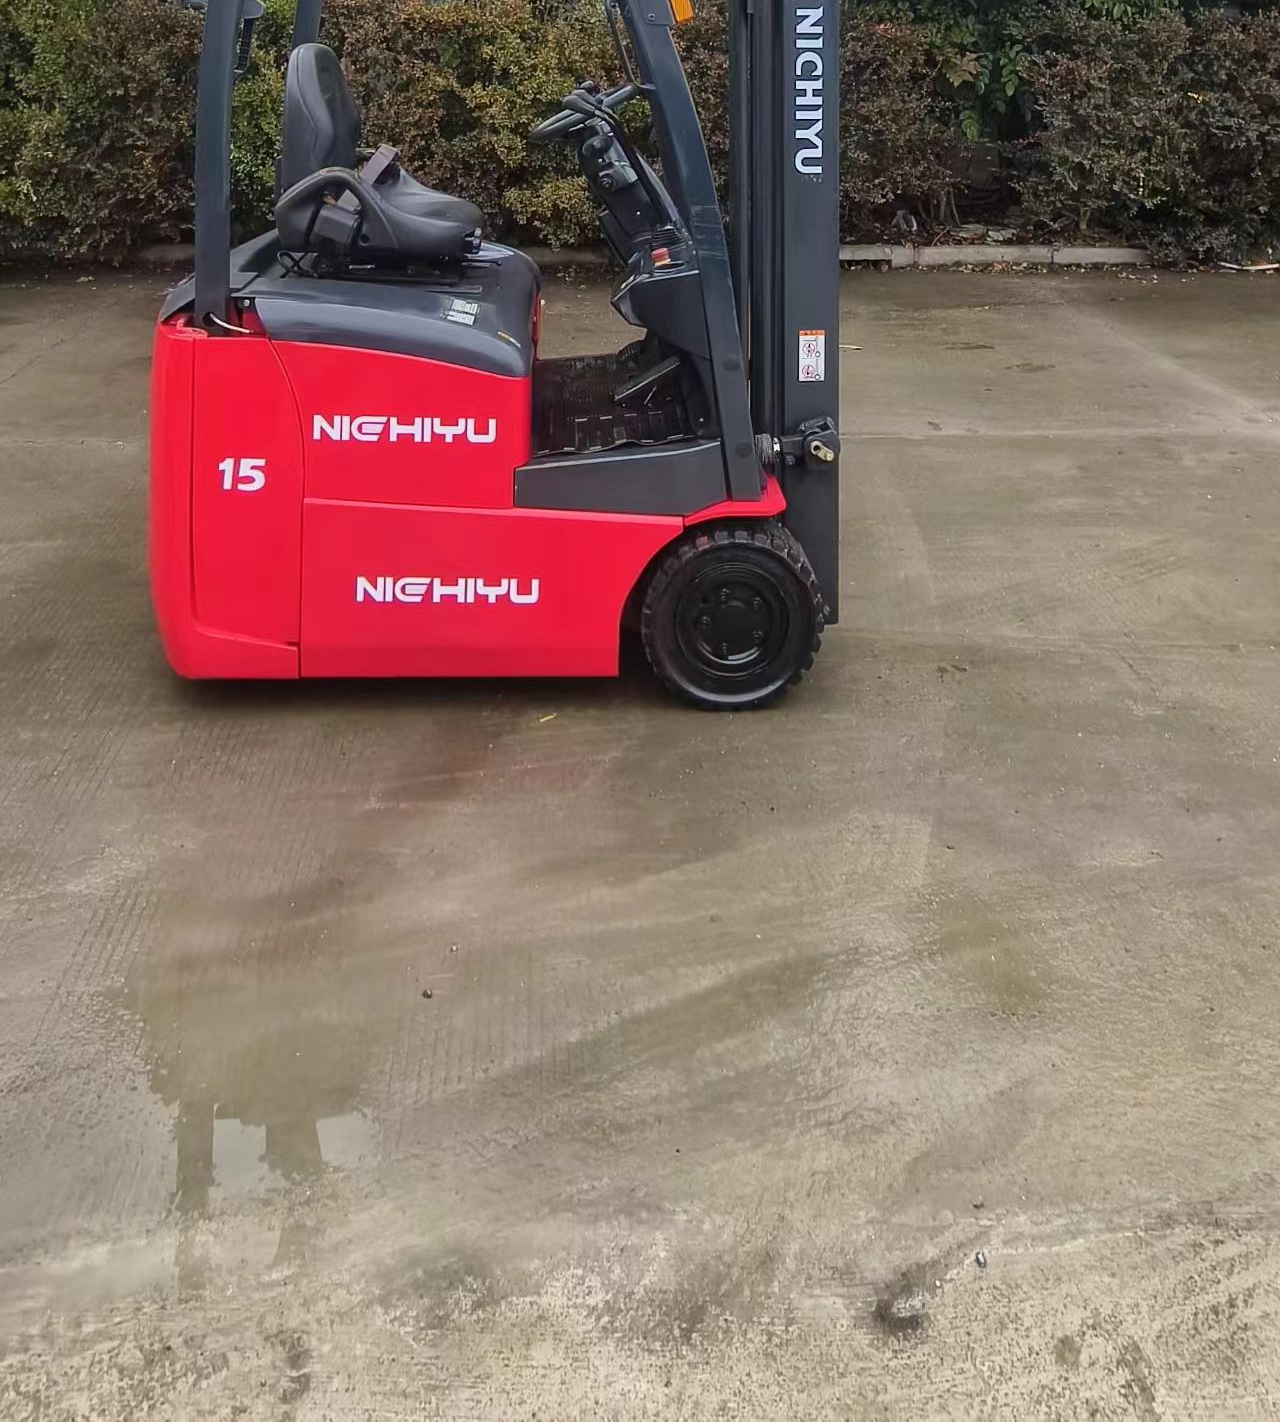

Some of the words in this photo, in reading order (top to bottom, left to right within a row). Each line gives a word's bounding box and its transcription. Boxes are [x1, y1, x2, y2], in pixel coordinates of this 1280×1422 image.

[795, 5, 824, 174] NICHIYU
[312, 414, 497, 443] NICHIYU
[218, 457, 267, 492] 15
[356, 576, 540, 604] NICHIYU
